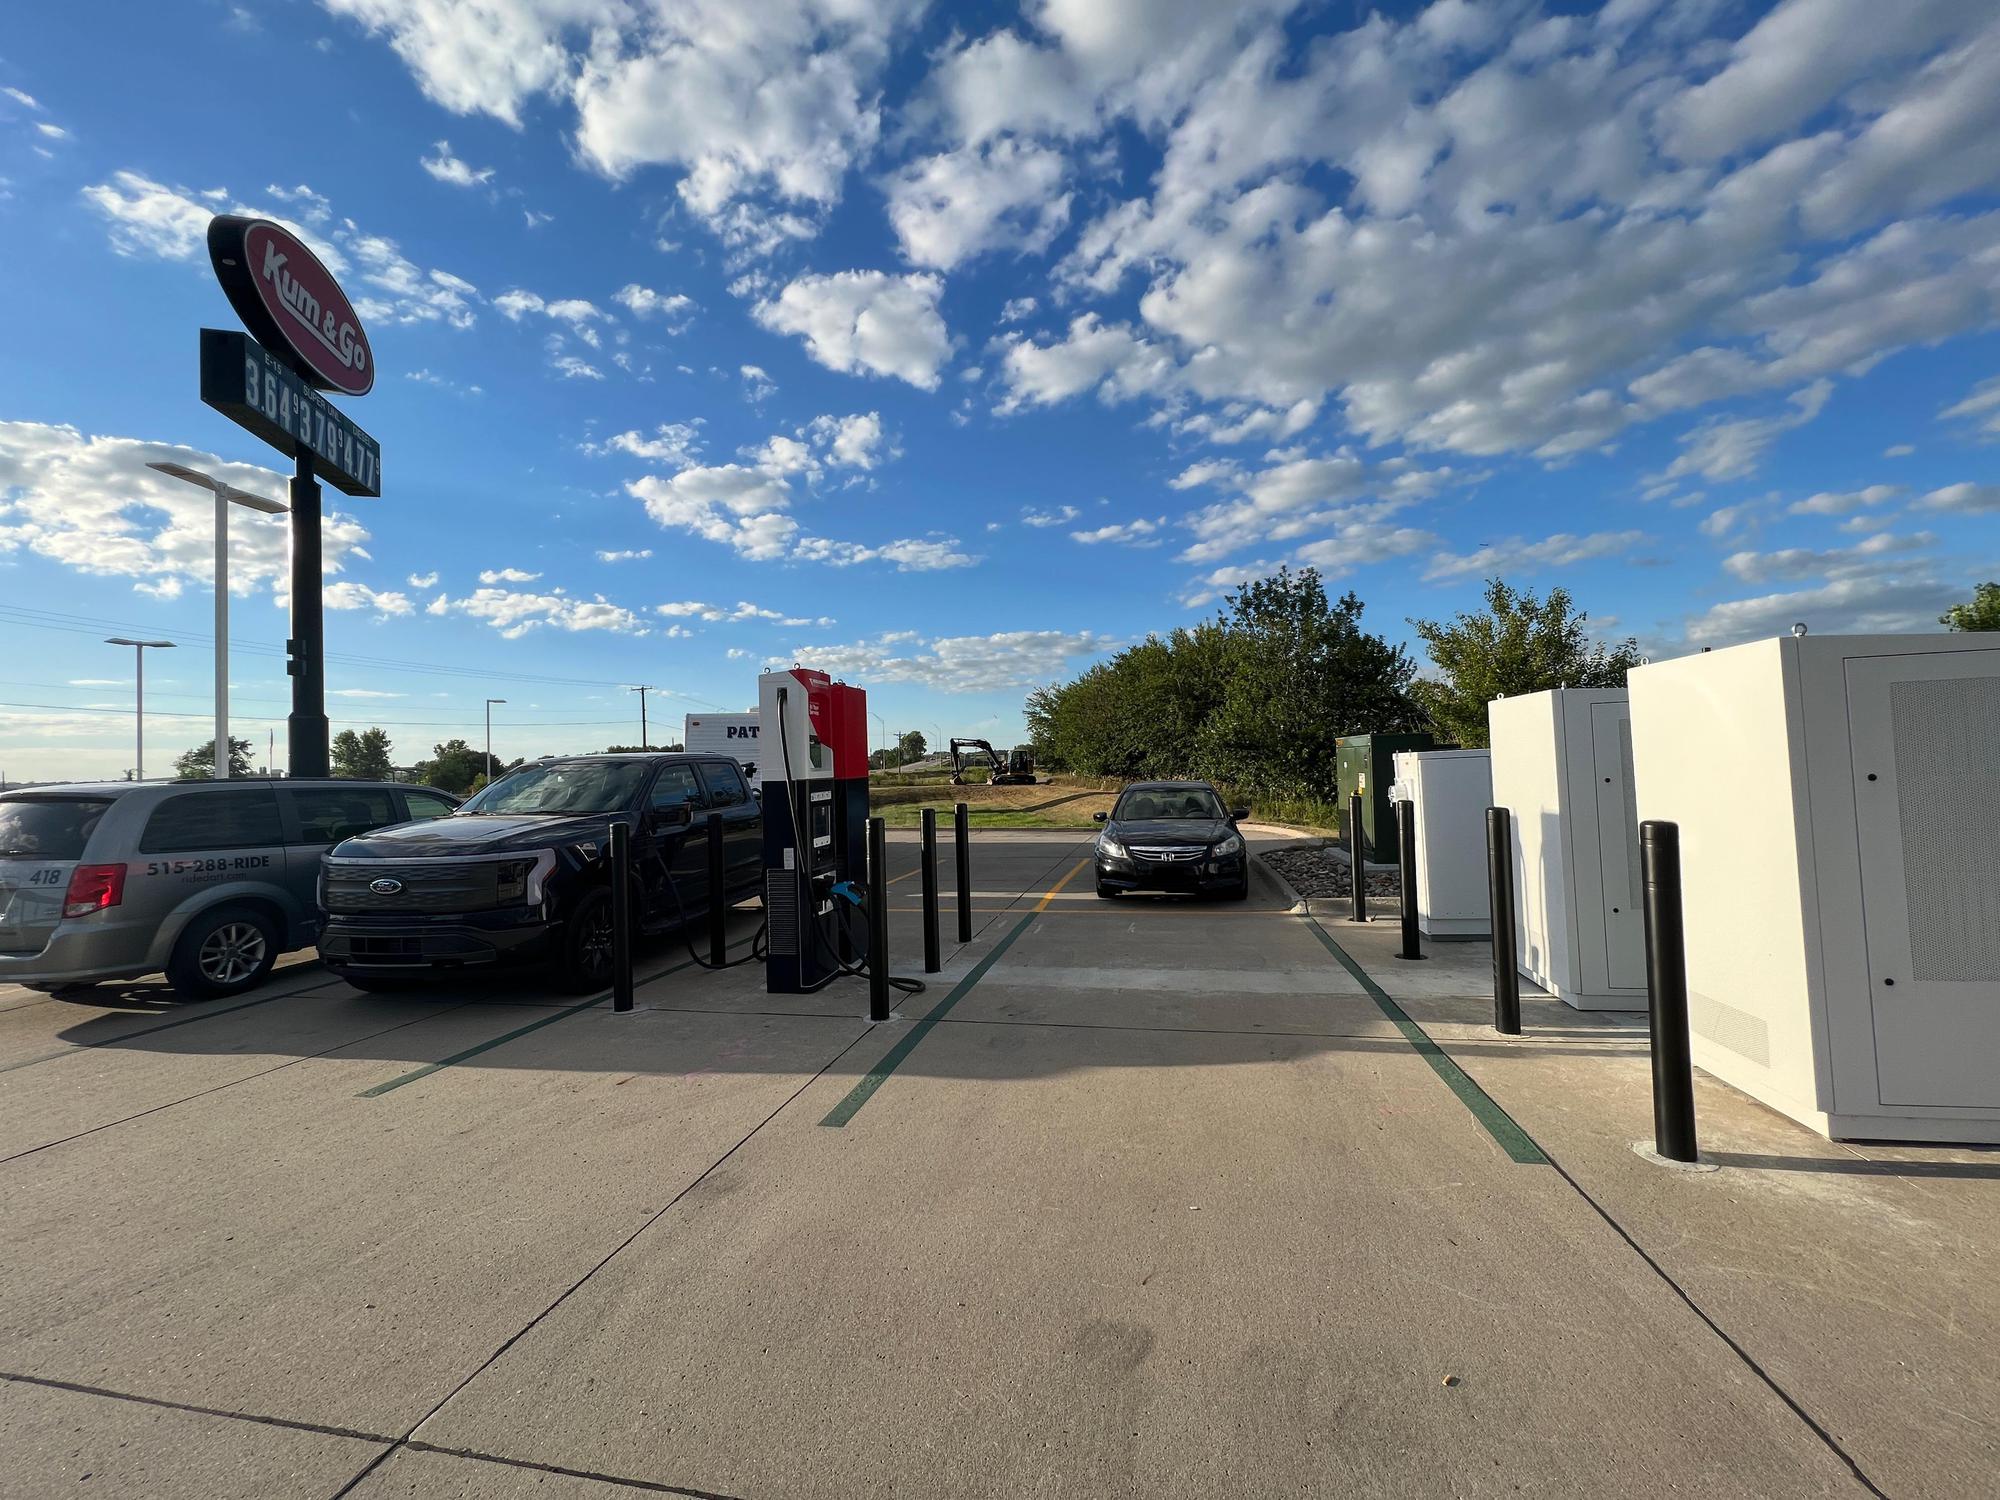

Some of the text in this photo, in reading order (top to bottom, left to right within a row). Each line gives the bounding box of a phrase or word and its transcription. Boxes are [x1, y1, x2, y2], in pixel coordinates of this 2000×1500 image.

[263, 239, 366, 371] Kum & Go
[264, 352, 282, 375] E-15
[303, 384, 326, 410] SUPER
[726, 726, 760, 738] PAT
[146, 856, 270, 876] 515-288-RIDE
[30, 869, 62, 885] 418
